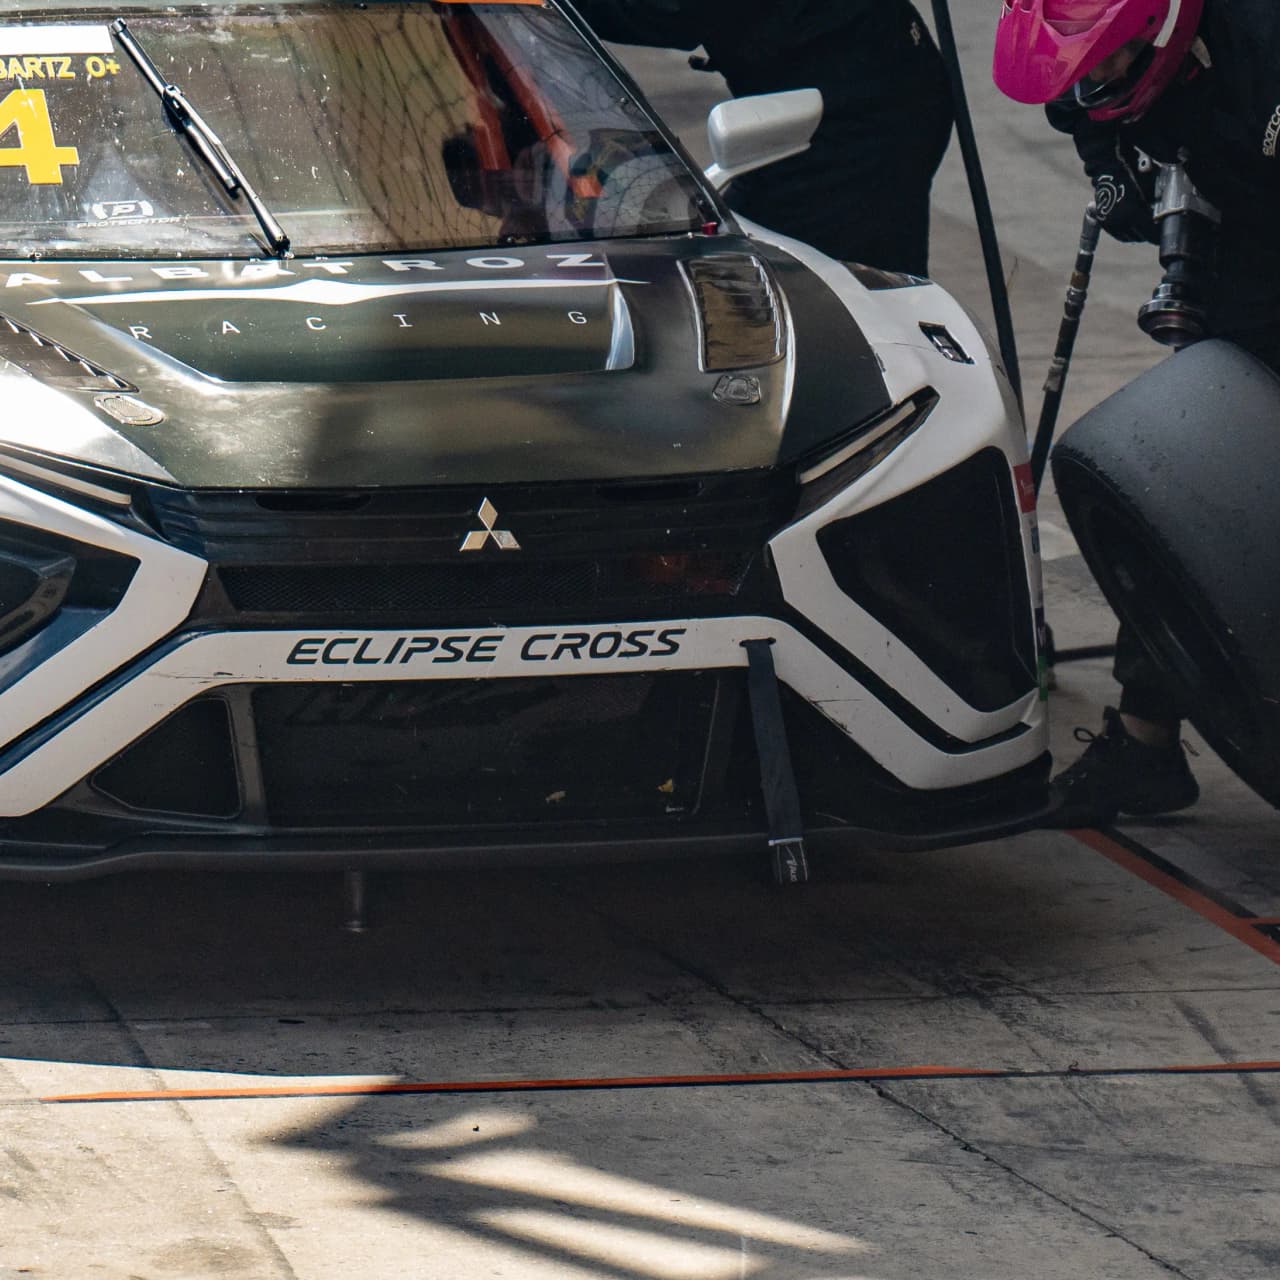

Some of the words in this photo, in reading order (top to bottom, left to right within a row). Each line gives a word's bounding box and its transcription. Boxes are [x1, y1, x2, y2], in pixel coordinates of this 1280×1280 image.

[4, 253, 608, 289] ALBATROZ
[127, 310, 589, 341] RACING
[286, 635, 504, 665] ECLIPSE
[520, 627, 687, 667] CROSS
